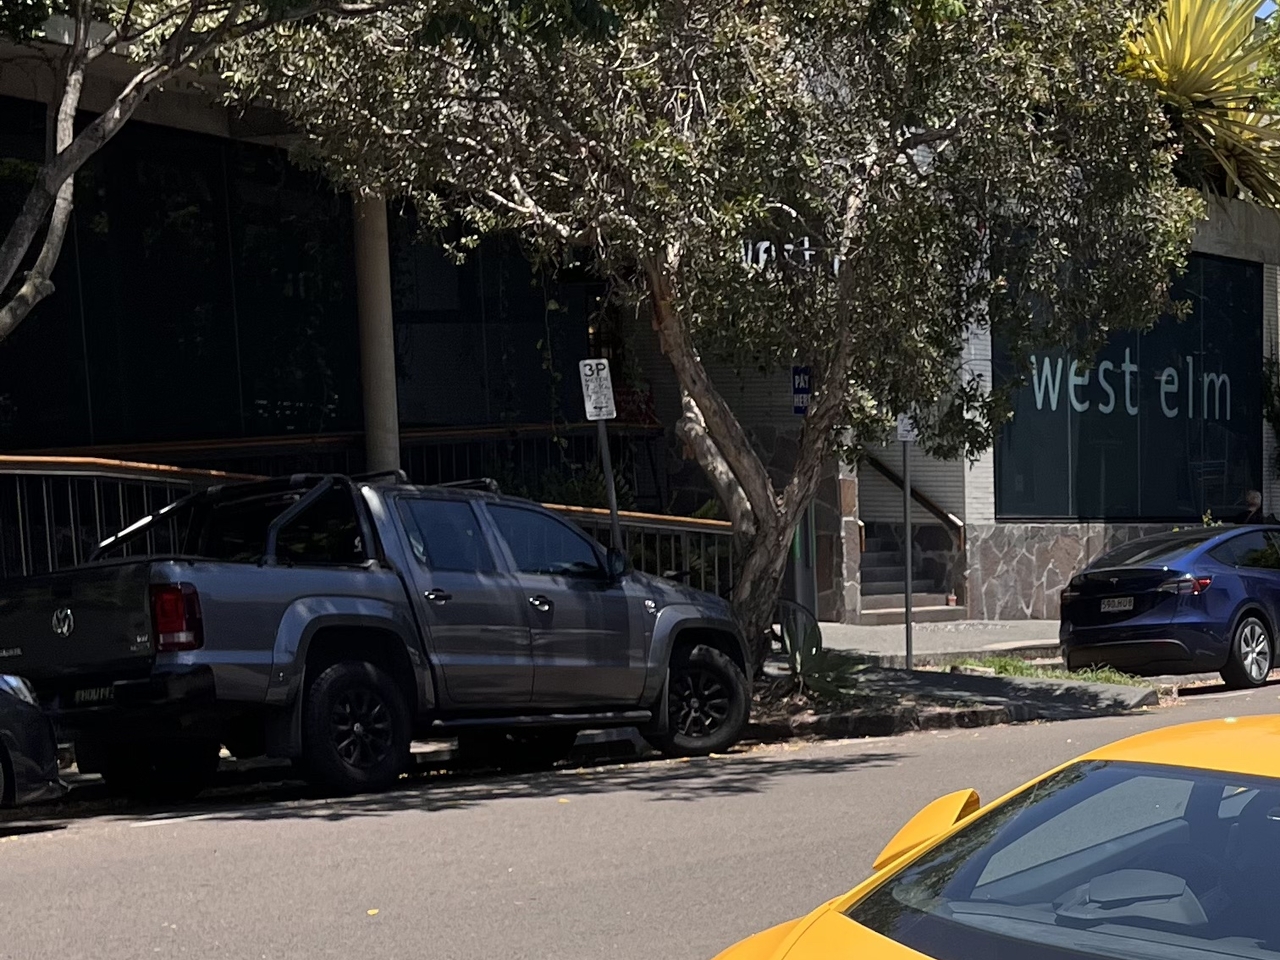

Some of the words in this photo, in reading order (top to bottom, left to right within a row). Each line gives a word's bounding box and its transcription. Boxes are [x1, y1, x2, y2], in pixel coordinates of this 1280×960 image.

[583, 362, 606, 377] 3P
[1029, 347, 1139, 416] west
[1159, 355, 1231, 421] elm
